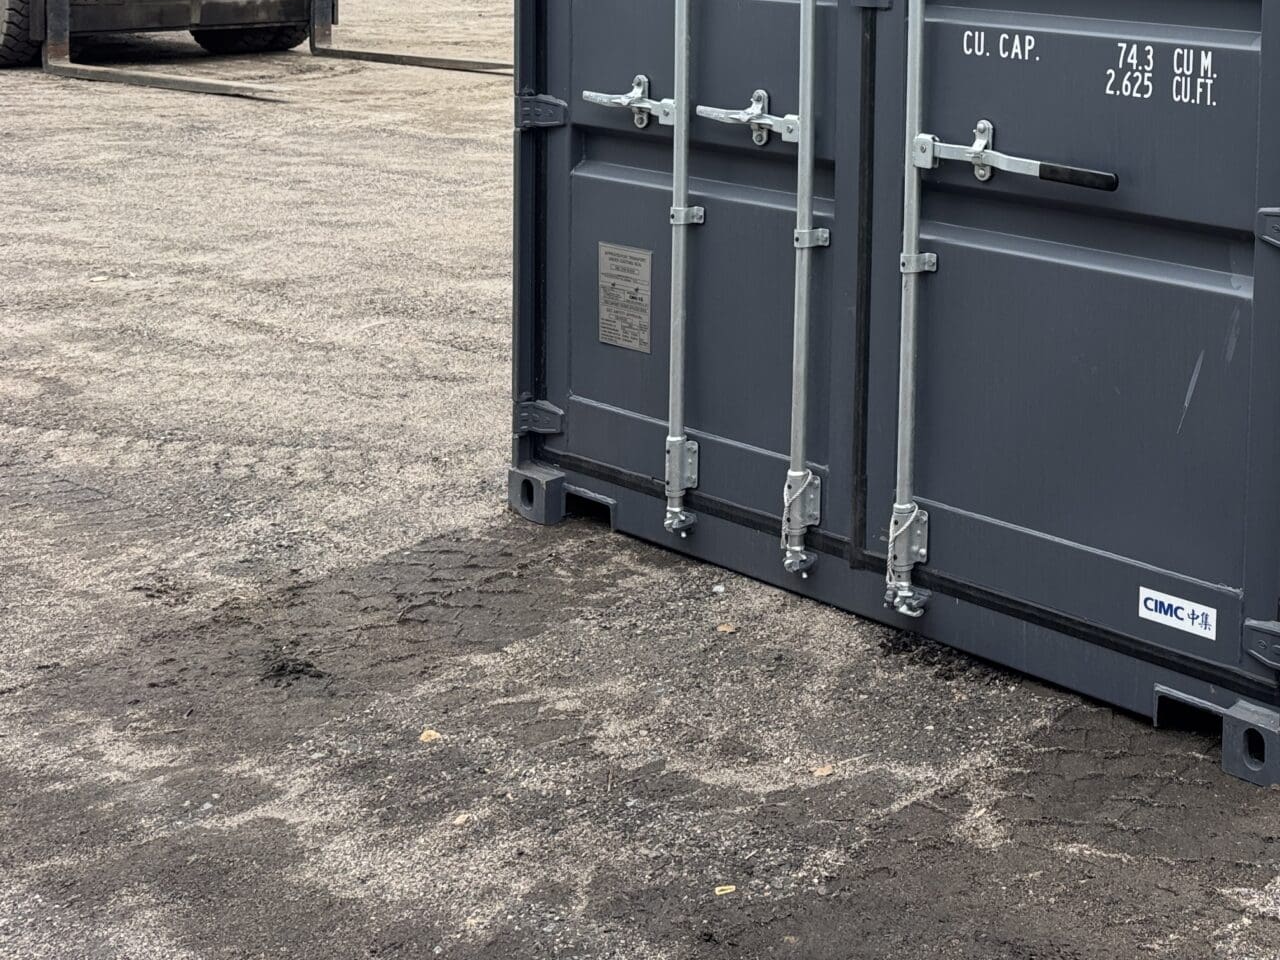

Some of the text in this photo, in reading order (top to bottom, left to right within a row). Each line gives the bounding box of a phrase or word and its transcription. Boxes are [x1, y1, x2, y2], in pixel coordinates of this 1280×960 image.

[963, 31, 1218, 79] CU. CAP. 74.3 CU M.
[1143, 596, 1185, 621] CIMC
